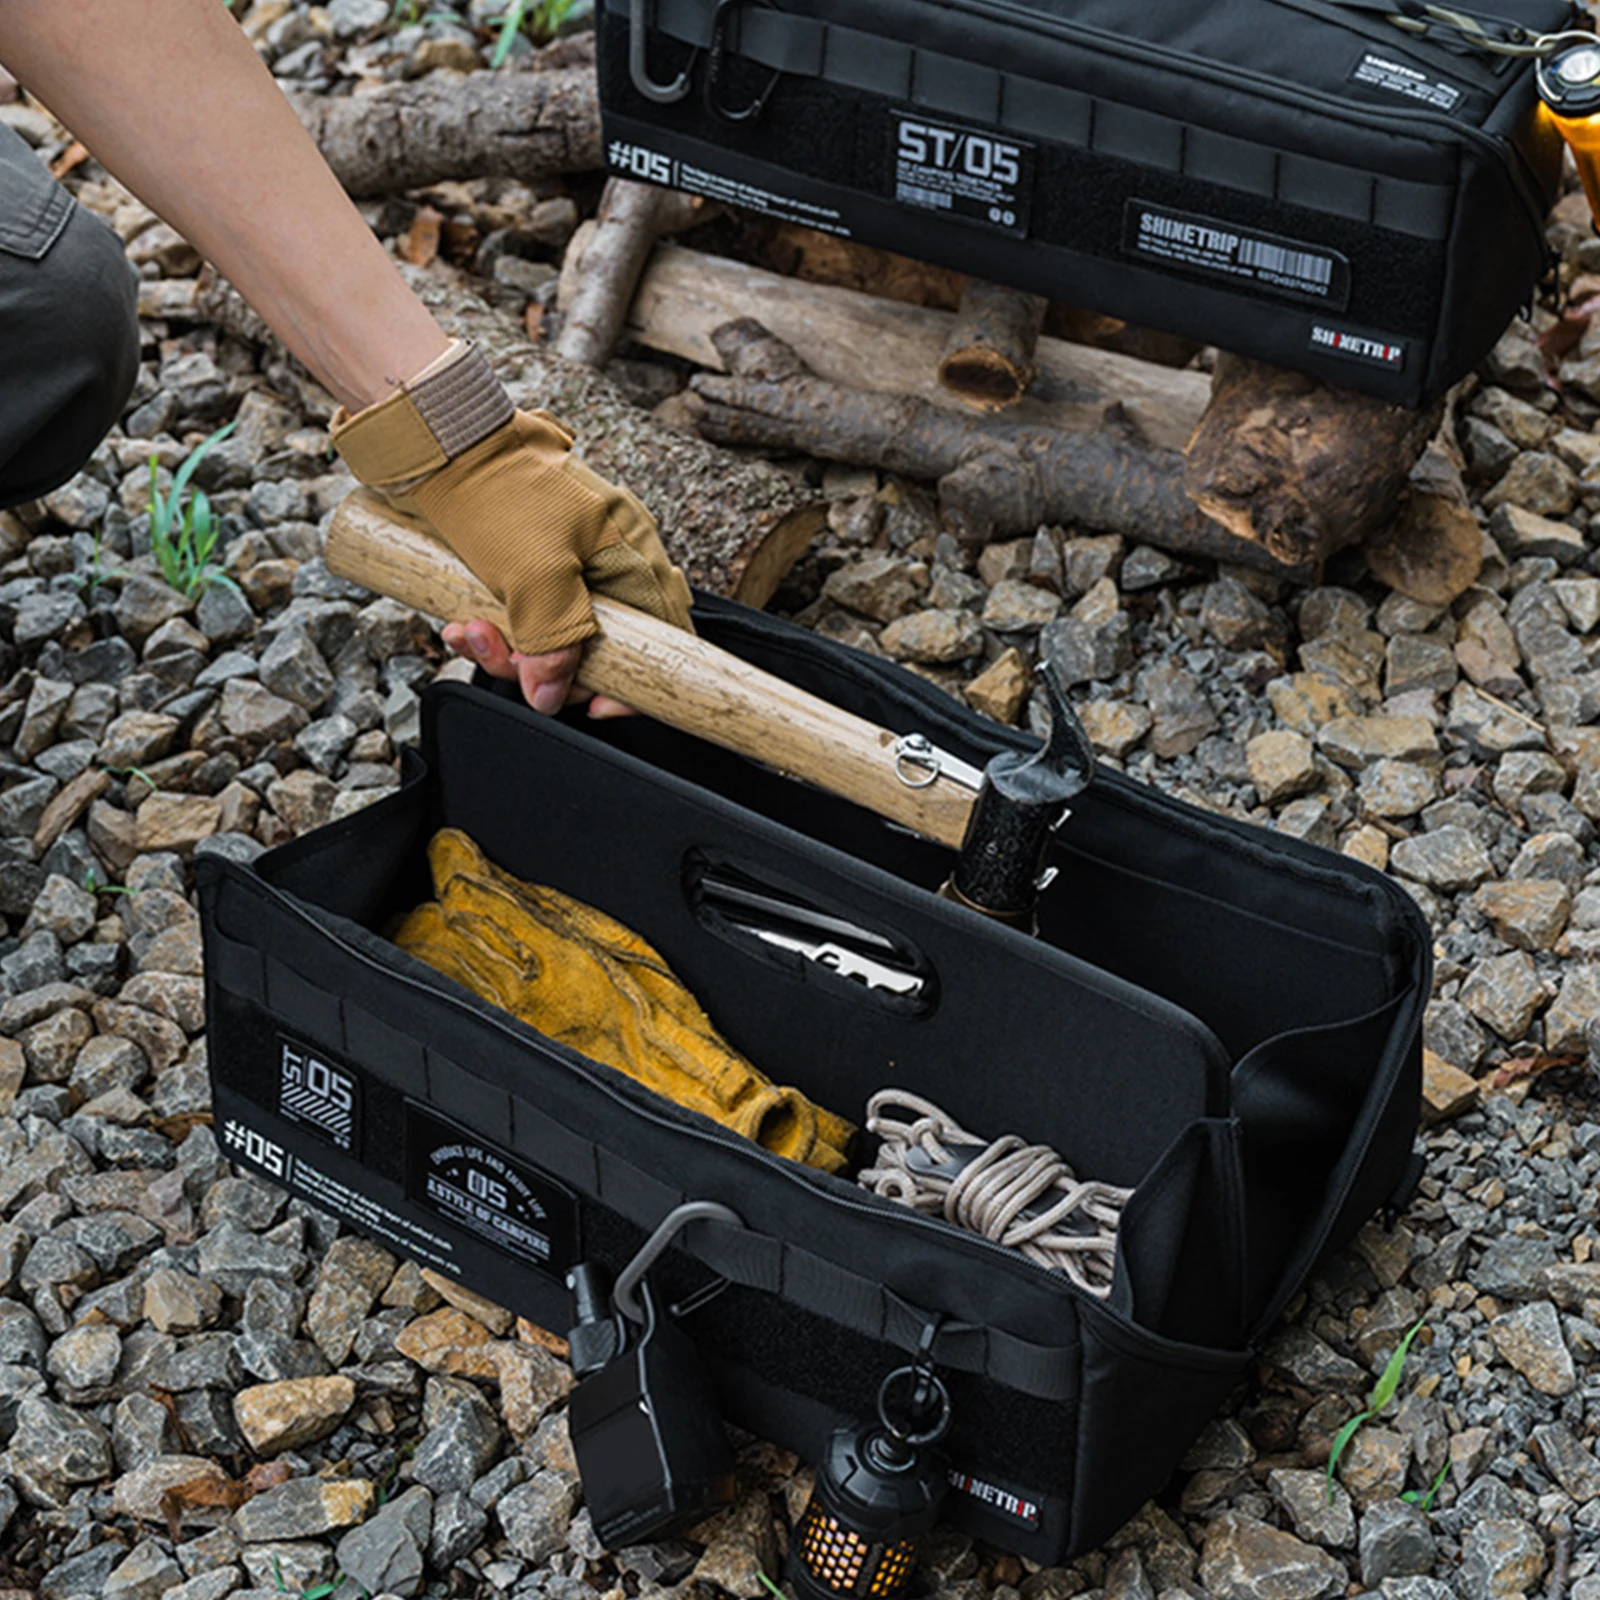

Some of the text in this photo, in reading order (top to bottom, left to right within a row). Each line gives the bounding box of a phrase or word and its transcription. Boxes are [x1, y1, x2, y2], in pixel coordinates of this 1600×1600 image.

[608, 140, 672, 185] #05
[898, 121, 1020, 185] ST/05
[307, 1059, 353, 1112] 05
[223, 1119, 284, 1177] #05
